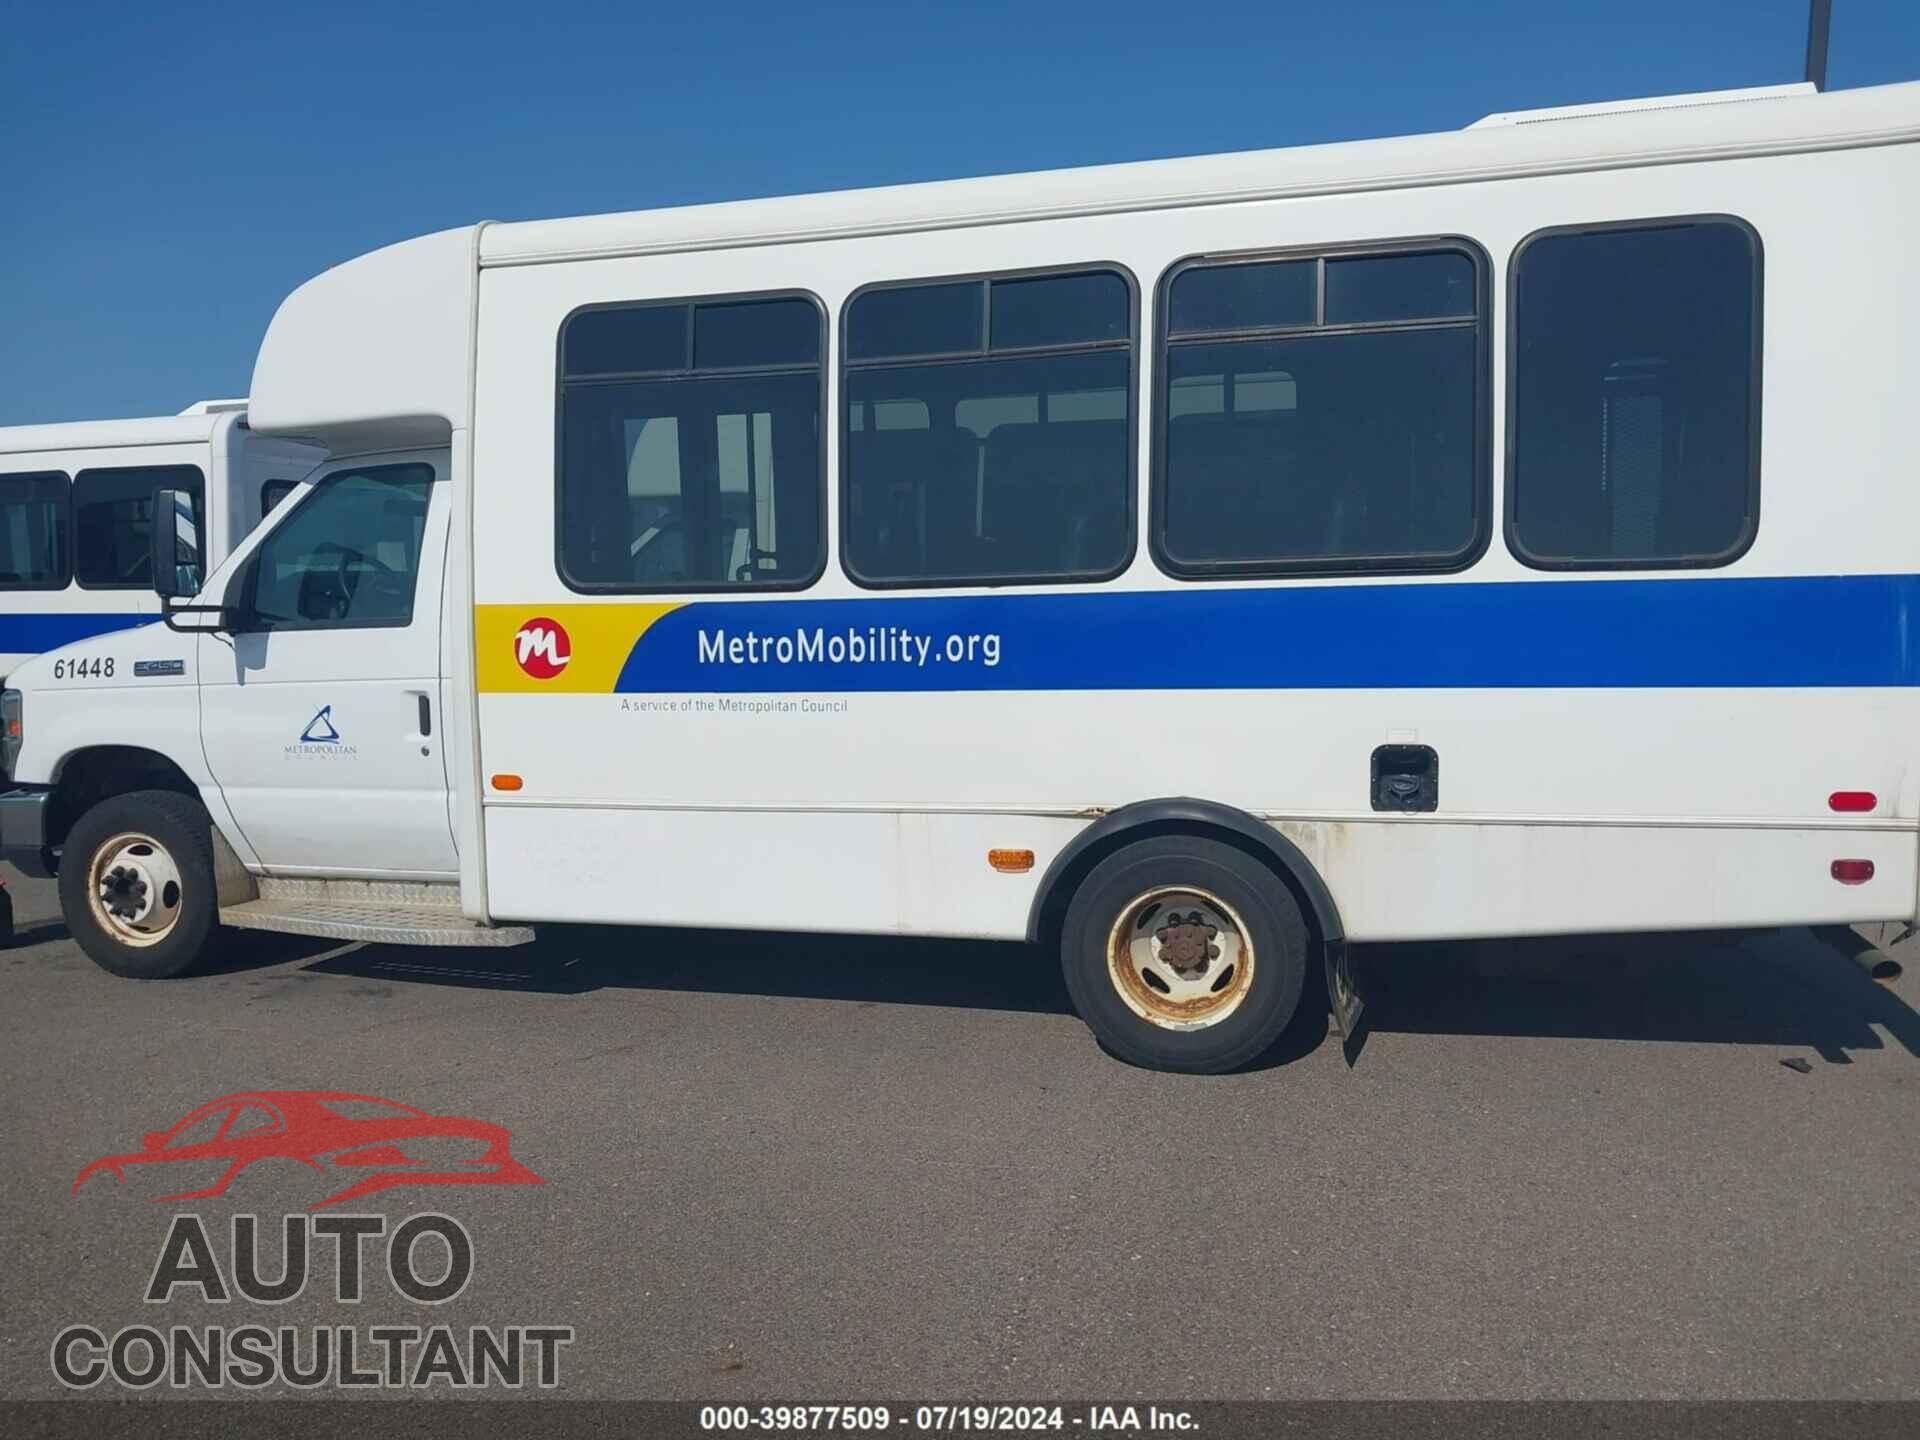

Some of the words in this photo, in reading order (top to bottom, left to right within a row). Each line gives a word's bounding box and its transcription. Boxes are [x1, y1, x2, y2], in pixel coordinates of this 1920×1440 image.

[698, 627, 1001, 667] MetroMobility.org
[54, 657, 115, 679] 61448
[621, 699, 630, 711] A
[633, 700, 677, 711] service
[680, 699, 692, 711] of
[695, 699, 715, 712] the
[718, 699, 798, 715] Metropolitan
[801, 699, 848, 713] Council
[284, 745, 357, 754] METROPOLITAN
